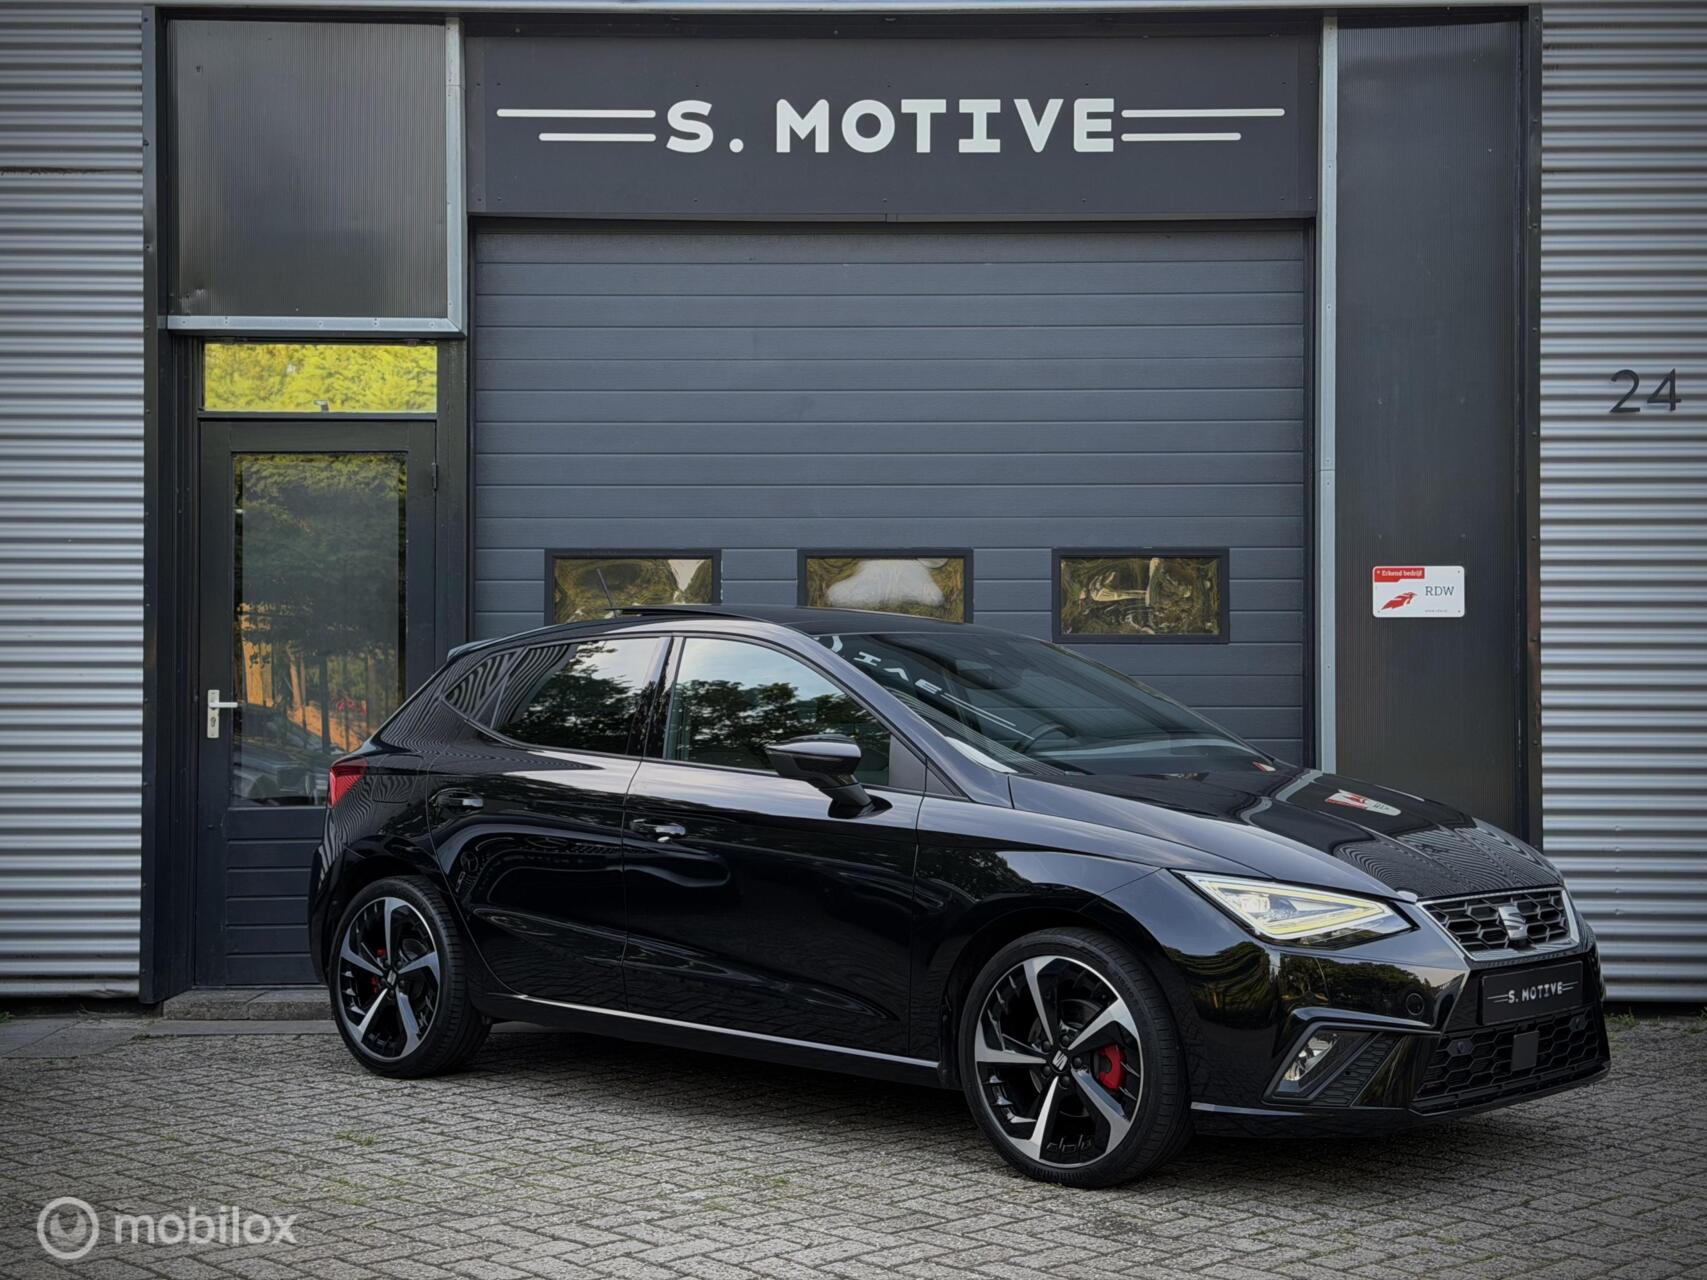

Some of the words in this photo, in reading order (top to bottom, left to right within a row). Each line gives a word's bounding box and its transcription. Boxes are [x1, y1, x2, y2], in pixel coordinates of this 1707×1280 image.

[665, 99, 745, 154] S.
[776, 97, 1115, 154] MOTIVE
[1610, 368, 1682, 413] 24
[1425, 586, 1455, 597] RDW
[1508, 990, 1519, 1004] S.
[1521, 981, 1563, 1003] MOTIVE
